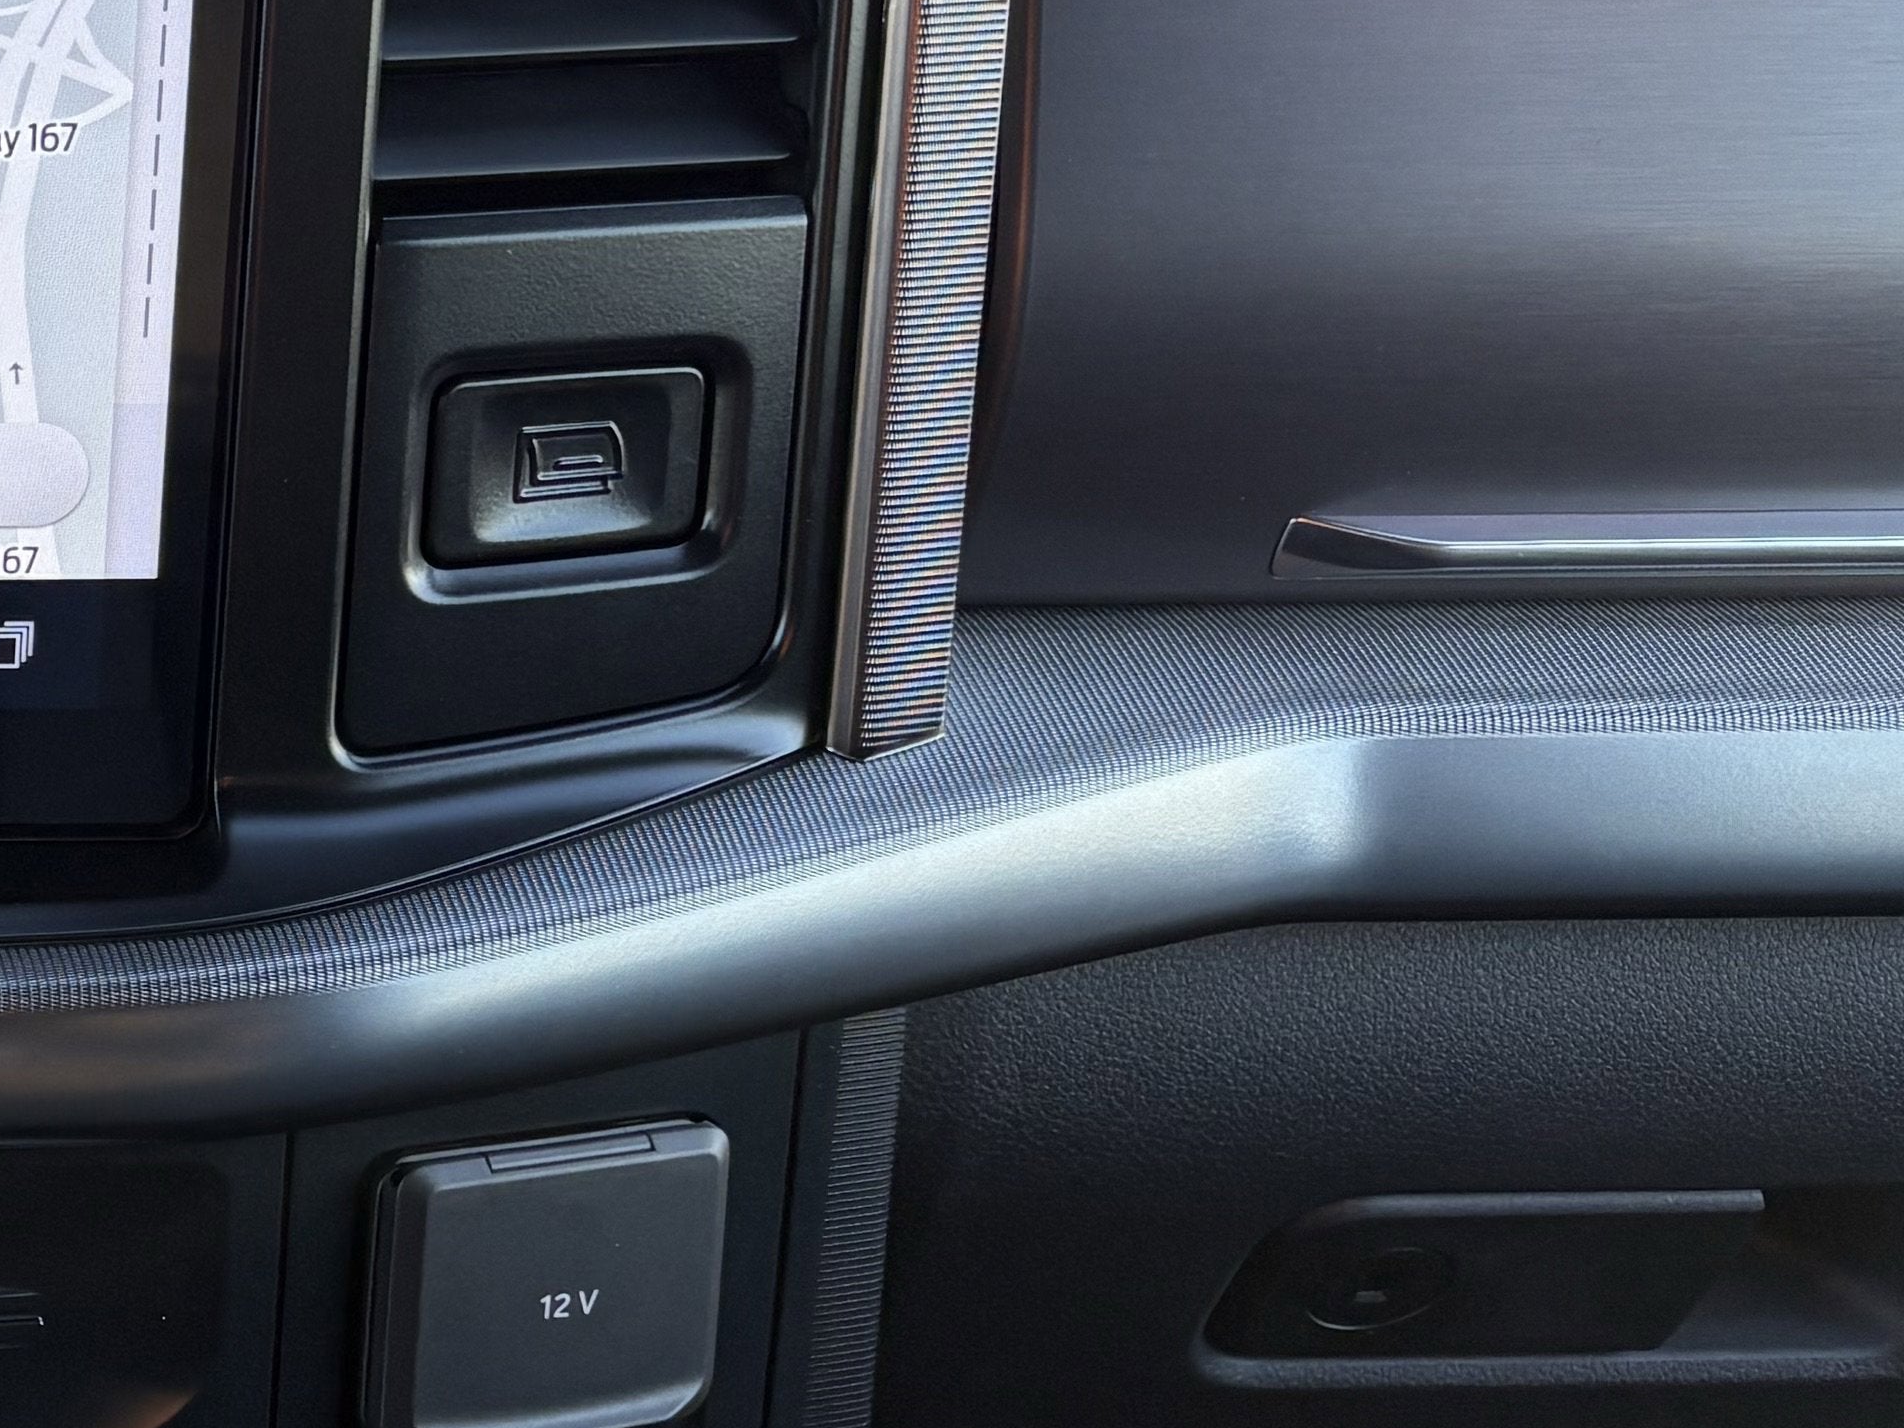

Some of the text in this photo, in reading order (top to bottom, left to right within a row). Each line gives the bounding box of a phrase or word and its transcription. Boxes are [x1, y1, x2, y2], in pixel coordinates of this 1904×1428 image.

[27, 123, 77, 153] 167
[540, 1289, 599, 1319] 12 V
